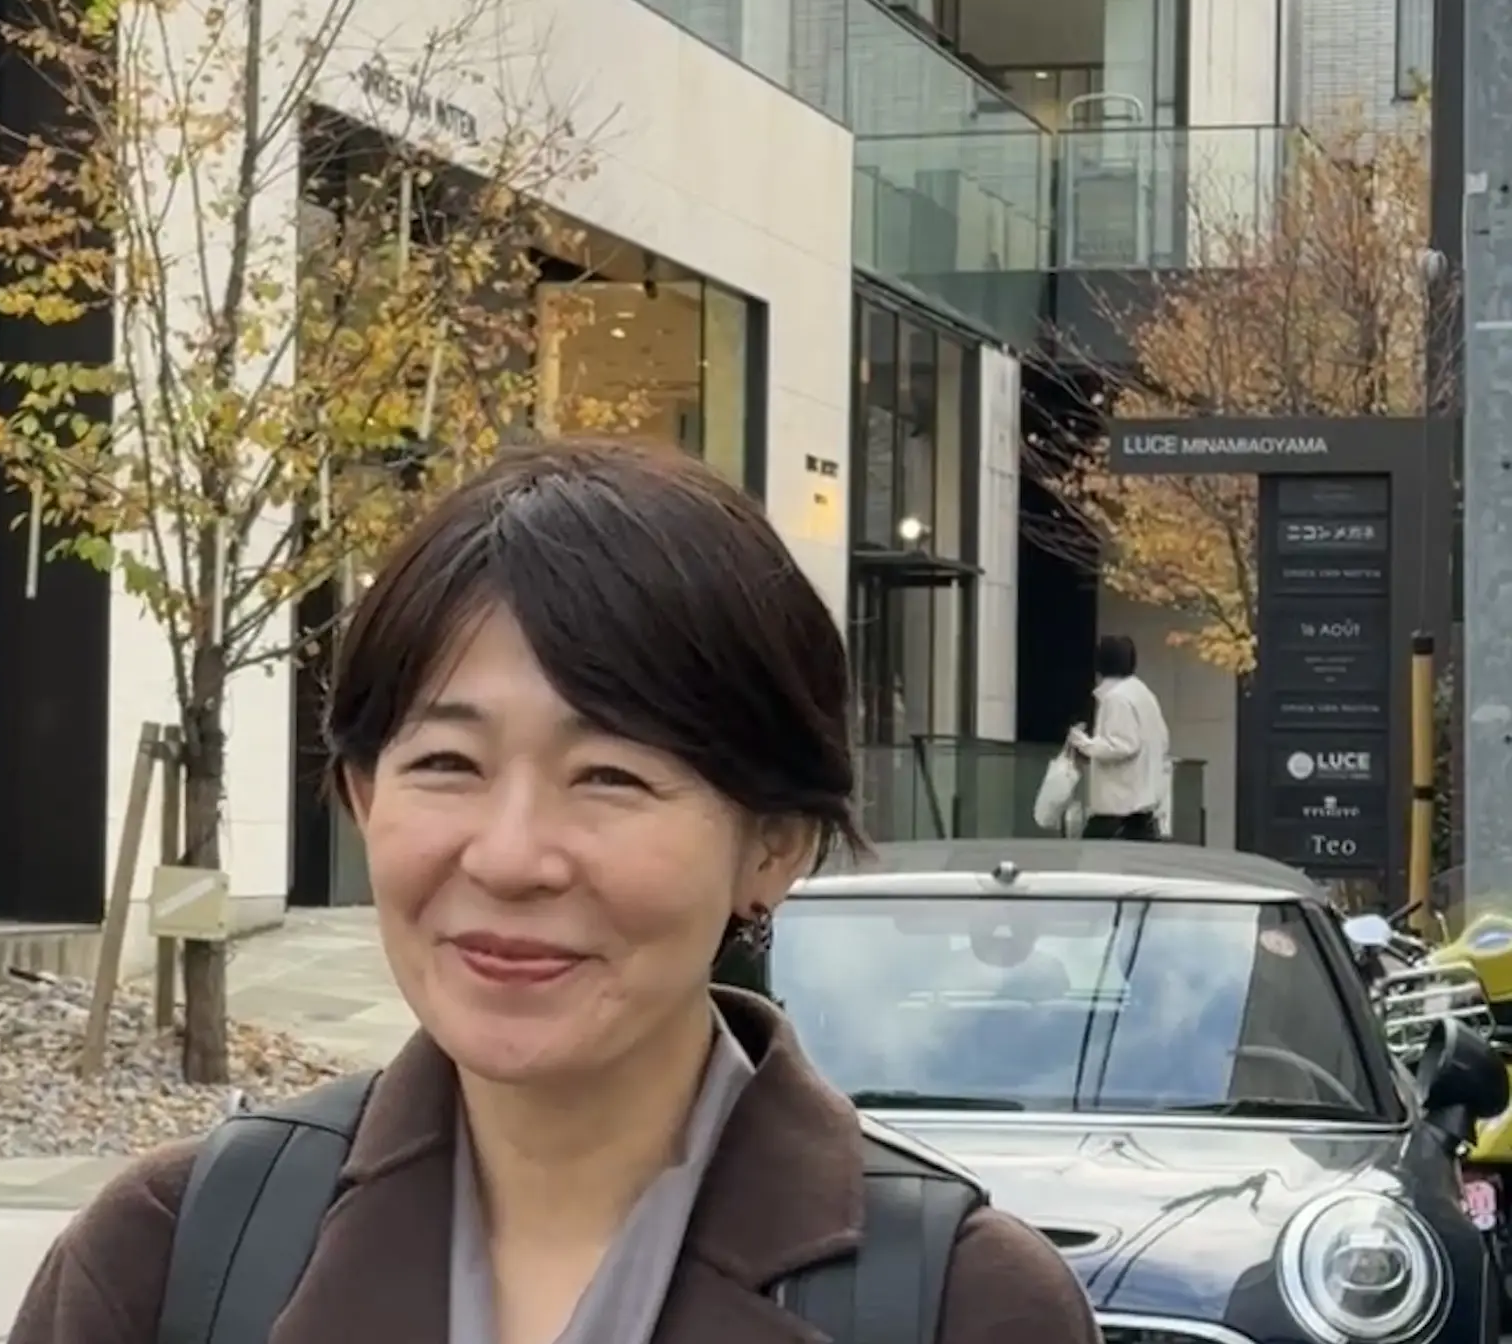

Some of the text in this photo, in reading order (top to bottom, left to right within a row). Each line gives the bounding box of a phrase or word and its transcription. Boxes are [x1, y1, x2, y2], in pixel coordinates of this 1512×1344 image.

[1122, 434, 1328, 454] LUCE MINAMIAOYAMA
[1317, 752, 1370, 770] LUCE
[1311, 835, 1356, 855] Teo
